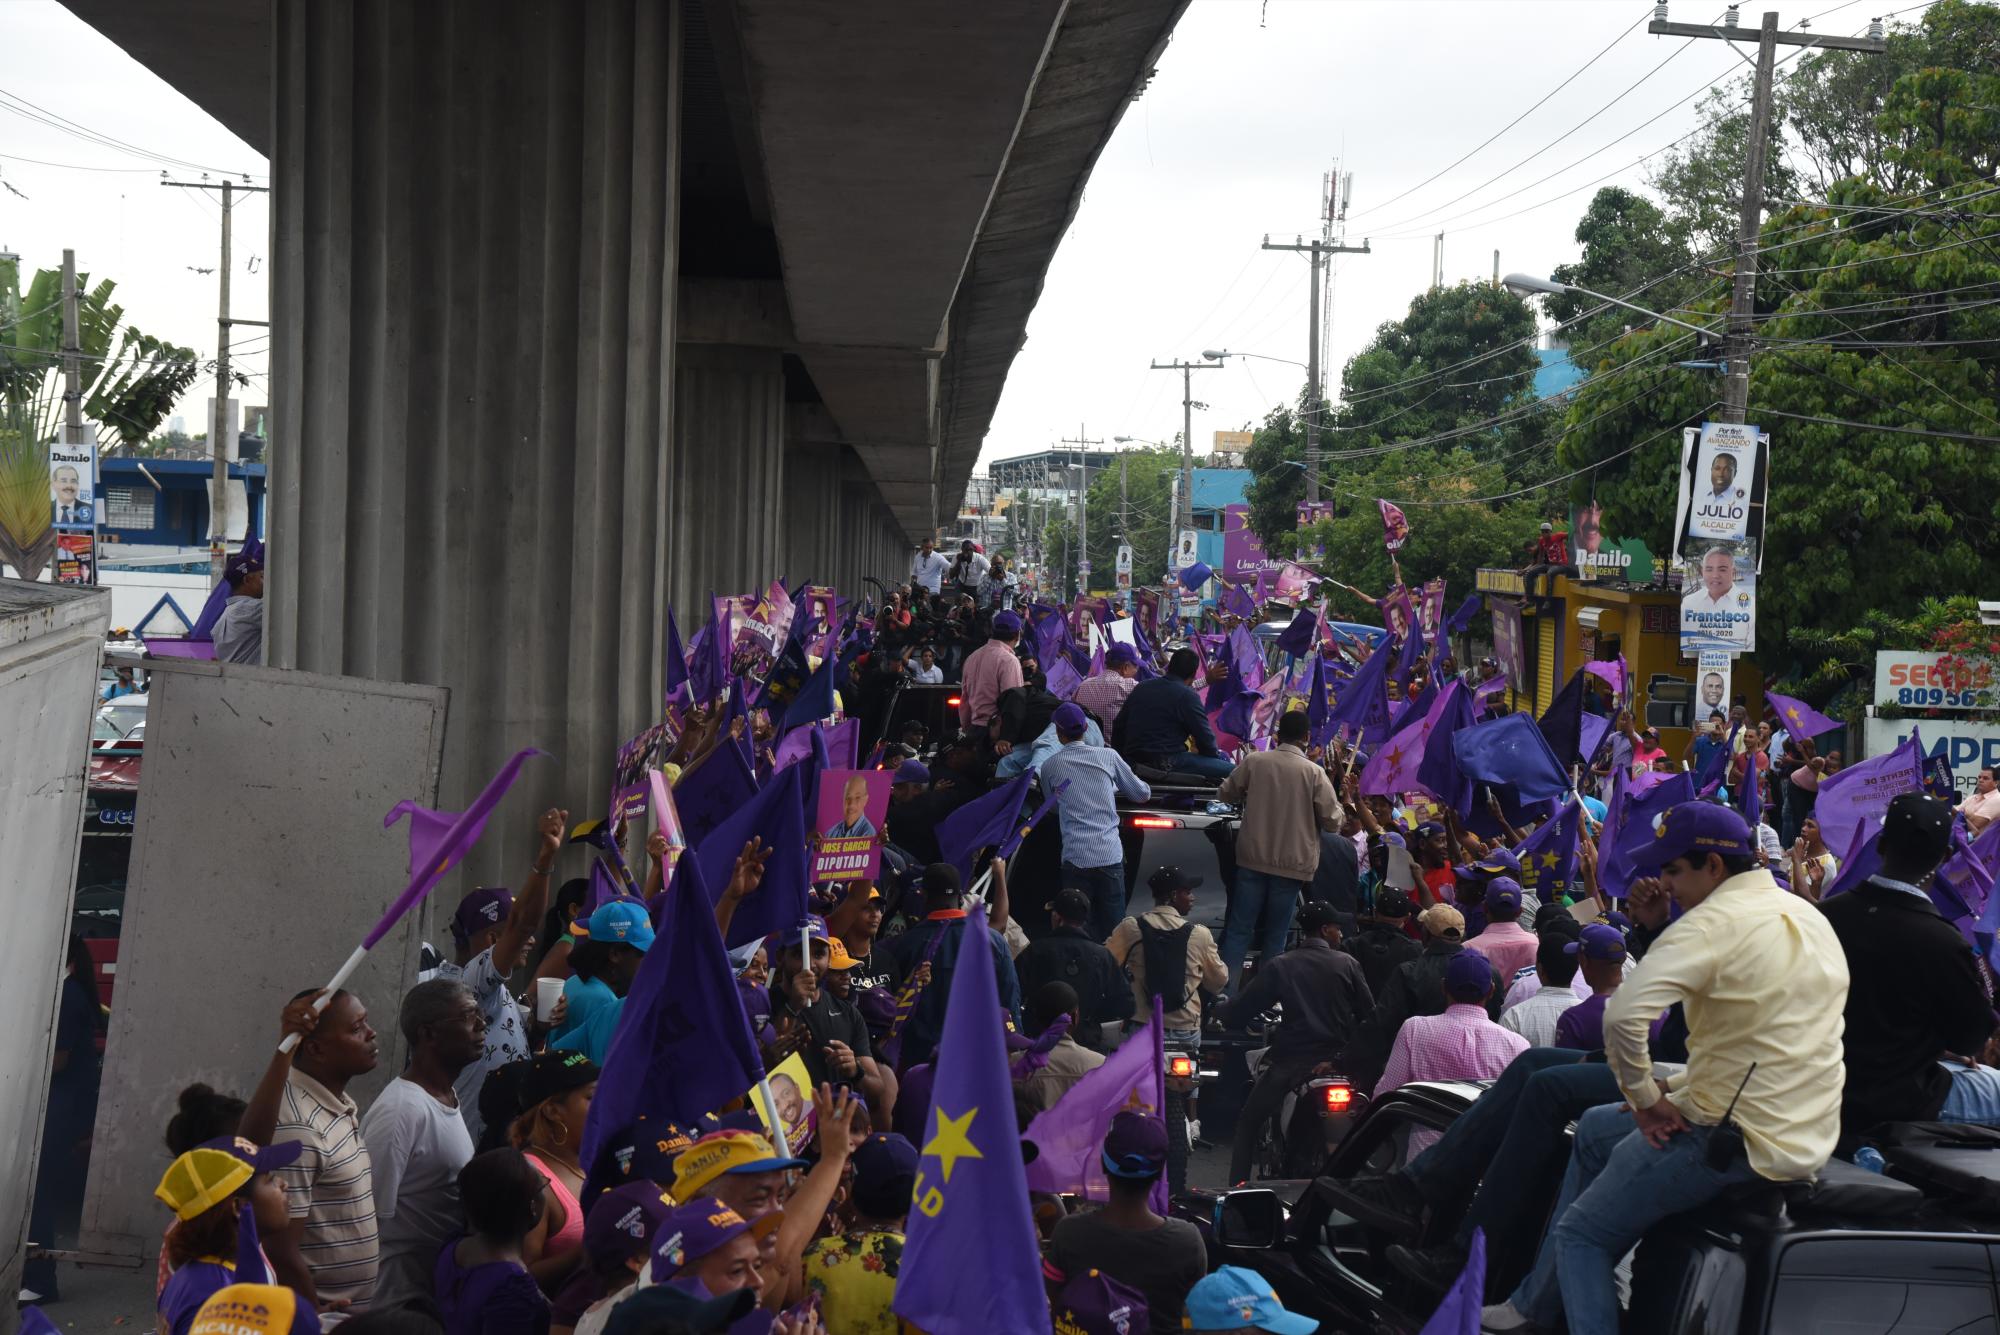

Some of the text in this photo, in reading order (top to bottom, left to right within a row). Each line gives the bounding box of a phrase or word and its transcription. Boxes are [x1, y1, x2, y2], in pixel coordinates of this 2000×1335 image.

[1708, 437, 1751, 447] AVANZANDO
[52, 453, 90, 462] Danilo
[1697, 504, 1743, 519] JULIO
[1701, 520, 1736, 530] ALCALDE
[1575, 549, 1632, 567] Danilo
[1237, 559, 1290, 571] Una Muje
[1584, 564, 1621, 576] PRESIDENTE
[1685, 609, 1750, 623] Francisco
[1700, 651, 1729, 660] Carlos
[822, 840, 871, 853] JOSE GARCIA
[817, 854, 870, 870] DIPUTADO
[656, 1135, 693, 1153] Danil
[685, 1144, 730, 1177] DANILO
